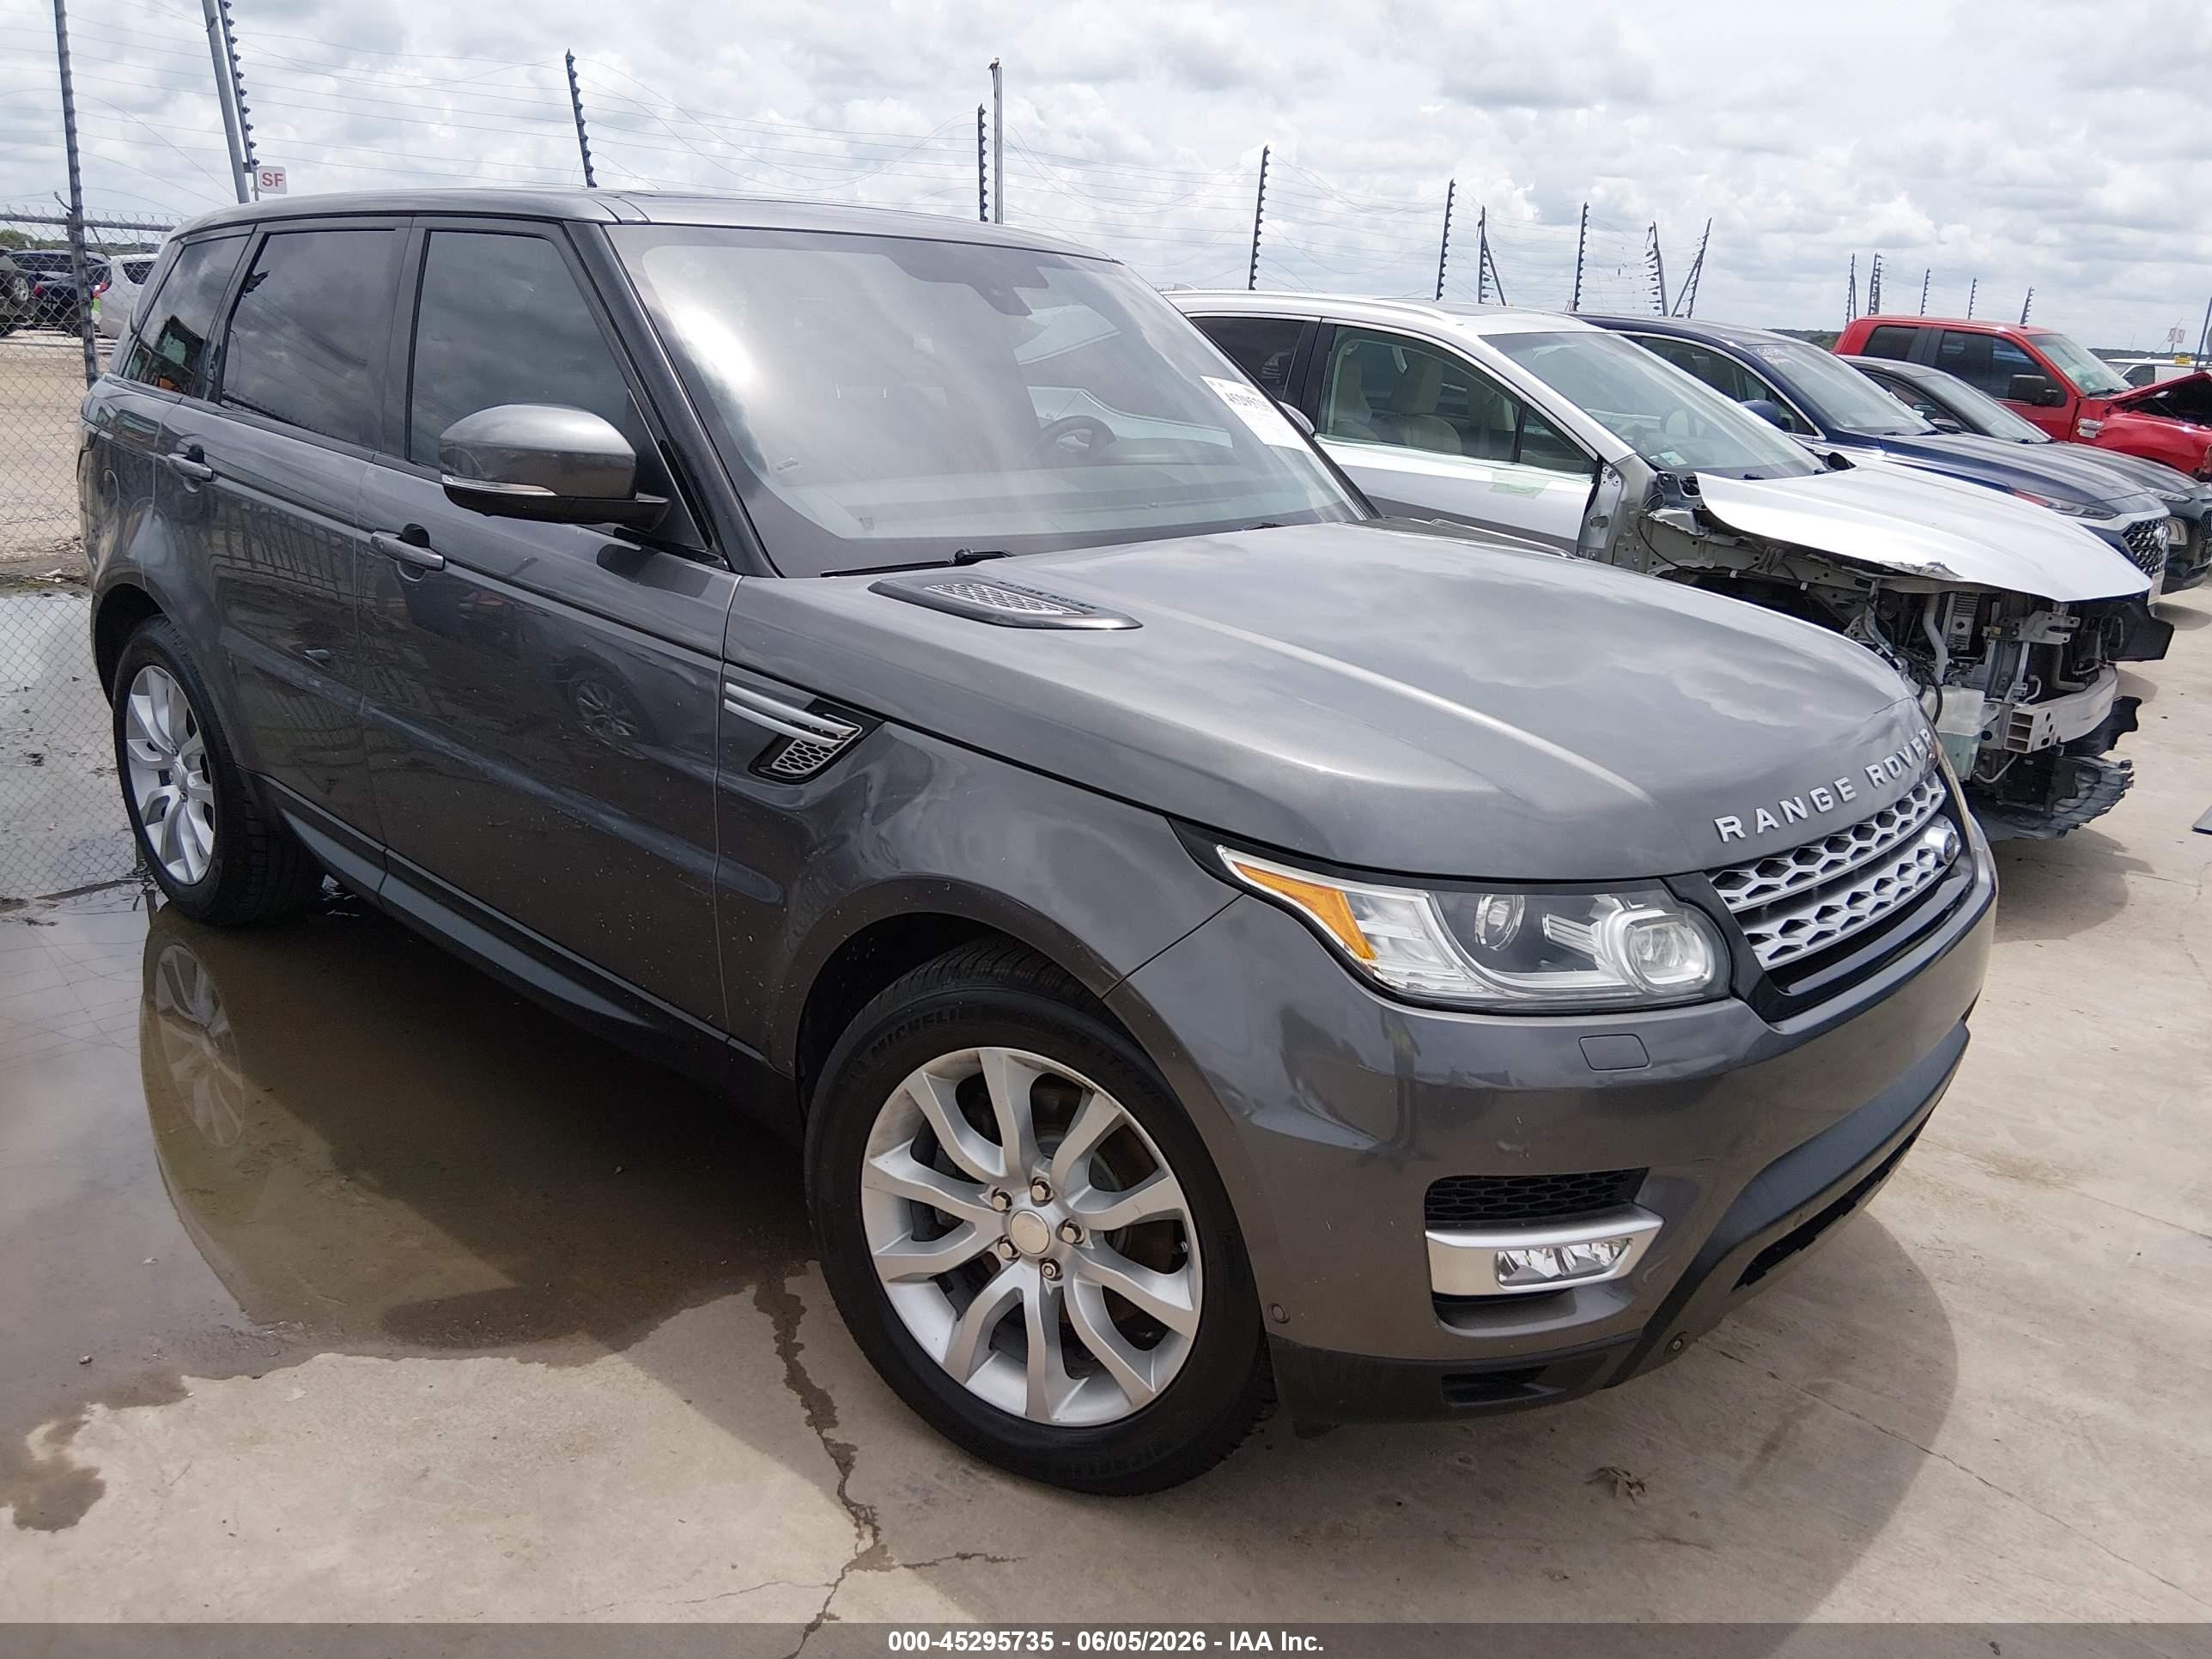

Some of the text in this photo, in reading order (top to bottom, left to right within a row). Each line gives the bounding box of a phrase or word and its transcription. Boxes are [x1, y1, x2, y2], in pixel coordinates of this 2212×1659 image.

[261, 172, 284, 187] SF
[1713, 728, 1932, 842] RANGE ROVER
